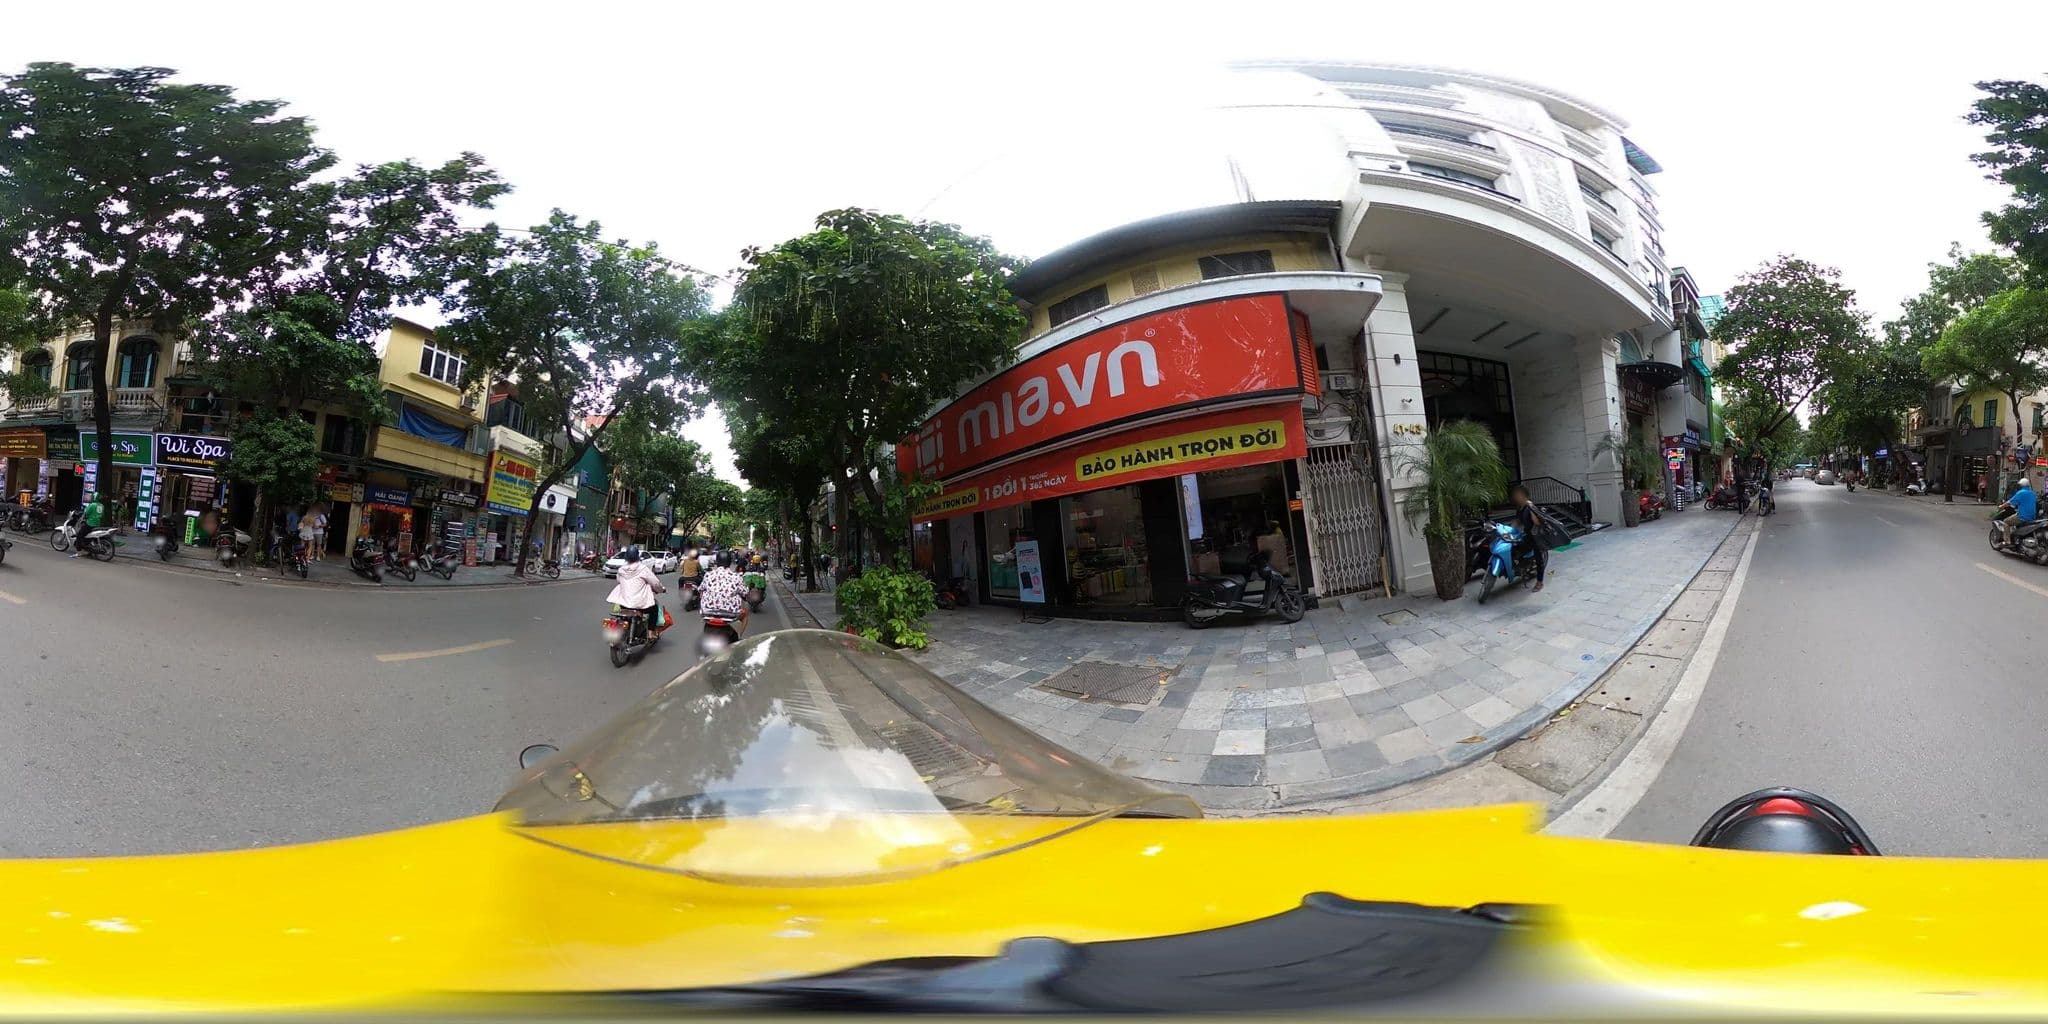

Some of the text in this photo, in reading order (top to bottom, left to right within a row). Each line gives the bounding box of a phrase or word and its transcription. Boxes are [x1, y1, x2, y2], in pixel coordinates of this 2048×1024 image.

[957, 340, 1161, 454] mia.vn
[121, 440, 139, 454] Spa
[161, 436, 226, 459] Wi Spa
[1082, 428, 1278, 476] BẢO HÀNH TRỌN ĐỜI
